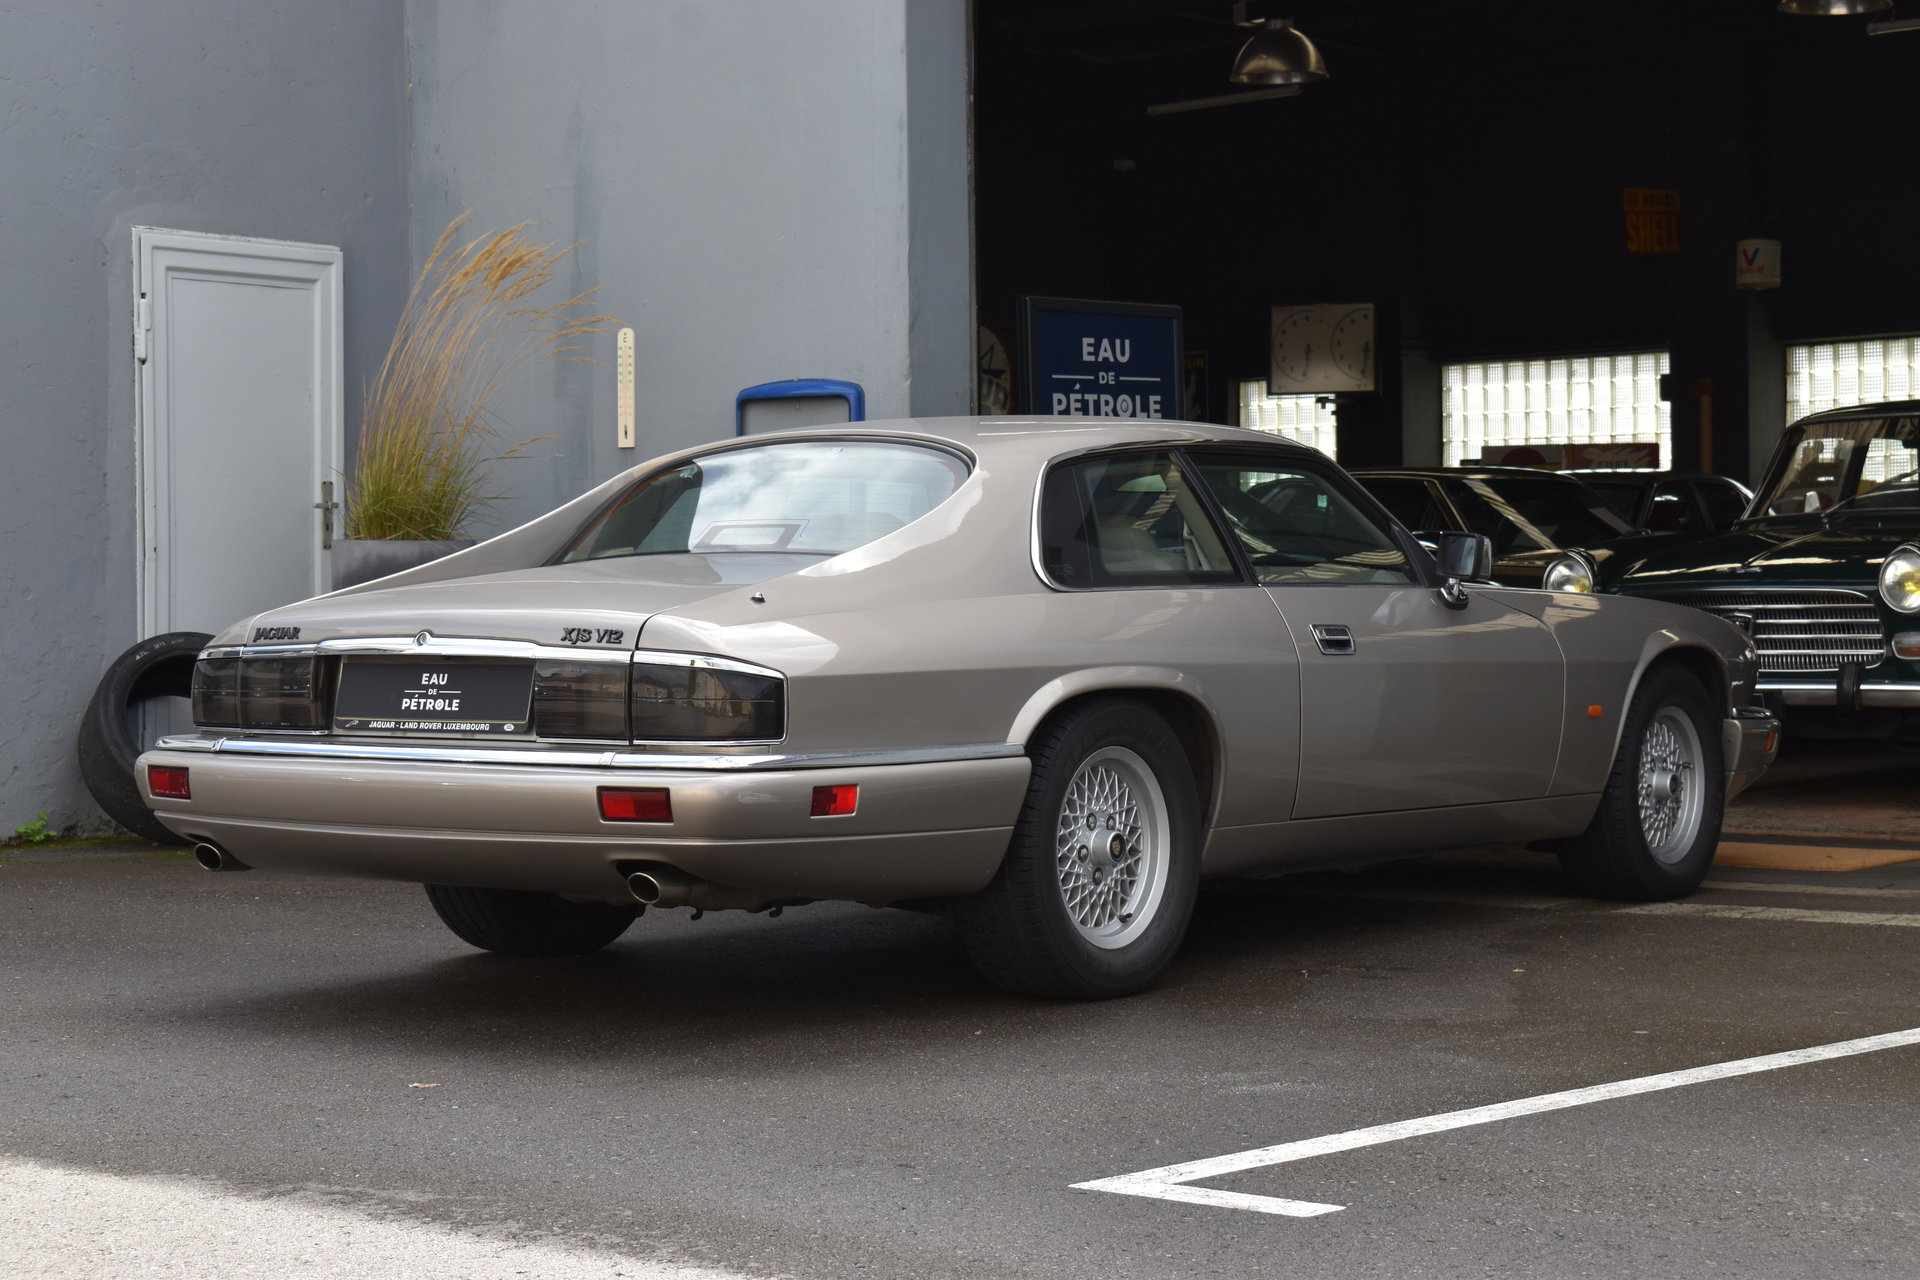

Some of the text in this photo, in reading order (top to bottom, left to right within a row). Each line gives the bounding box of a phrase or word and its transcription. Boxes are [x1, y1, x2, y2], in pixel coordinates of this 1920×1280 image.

[1626, 213, 1680, 253] SHELL
[1082, 337, 1130, 363] EAU
[1098, 371, 1116, 385] DE
[1052, 383, 1162, 419] PÉTROLE
[253, 626, 301, 643] JAGUAR
[560, 627, 624, 645] XJS V12
[421, 673, 448, 685] EAU
[401, 694, 460, 711] PÉTROLE
[368, 720, 395, 729] JAGUAR
[400, 721, 418, 729] LAND
[419, 722, 442, 730] ROVER
[443, 722, 490, 731] LUXEMBOURG
